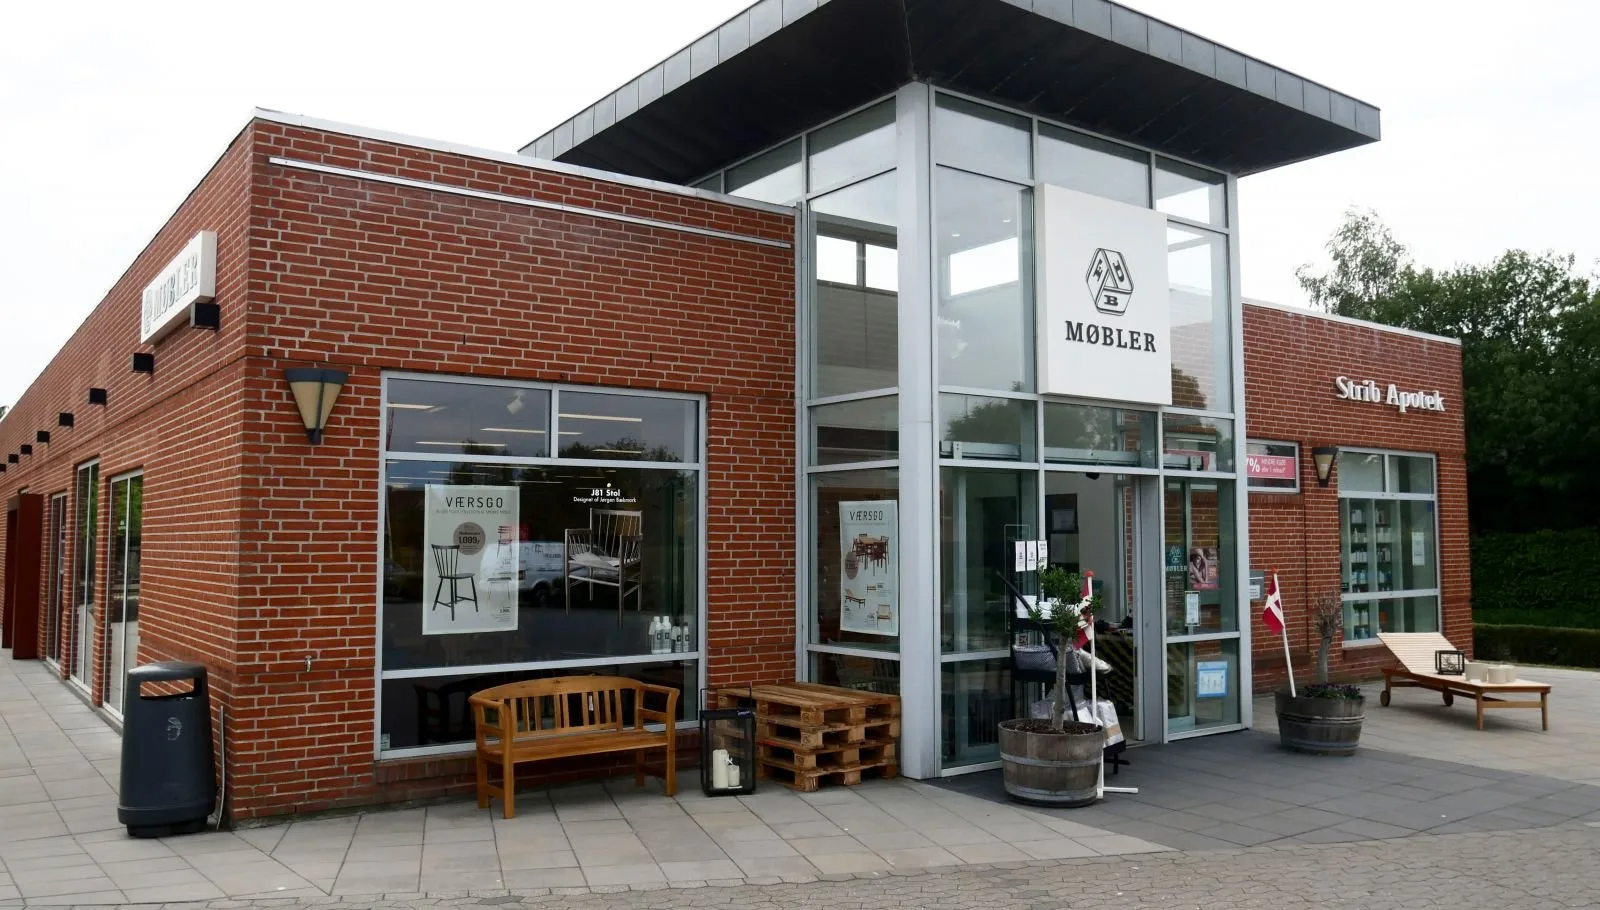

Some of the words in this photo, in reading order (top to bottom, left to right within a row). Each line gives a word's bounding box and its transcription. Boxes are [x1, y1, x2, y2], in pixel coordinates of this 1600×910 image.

[1065, 320, 1156, 353] MØBLER
[1336, 375, 1380, 402] Strib
[1385, 384, 1445, 412] Apotek
[591, 489, 603, 497] J81
[606, 488, 620, 497] Stol
[445, 496, 503, 508] VÆRSGO
[850, 510, 883, 521] VÆRSGO
